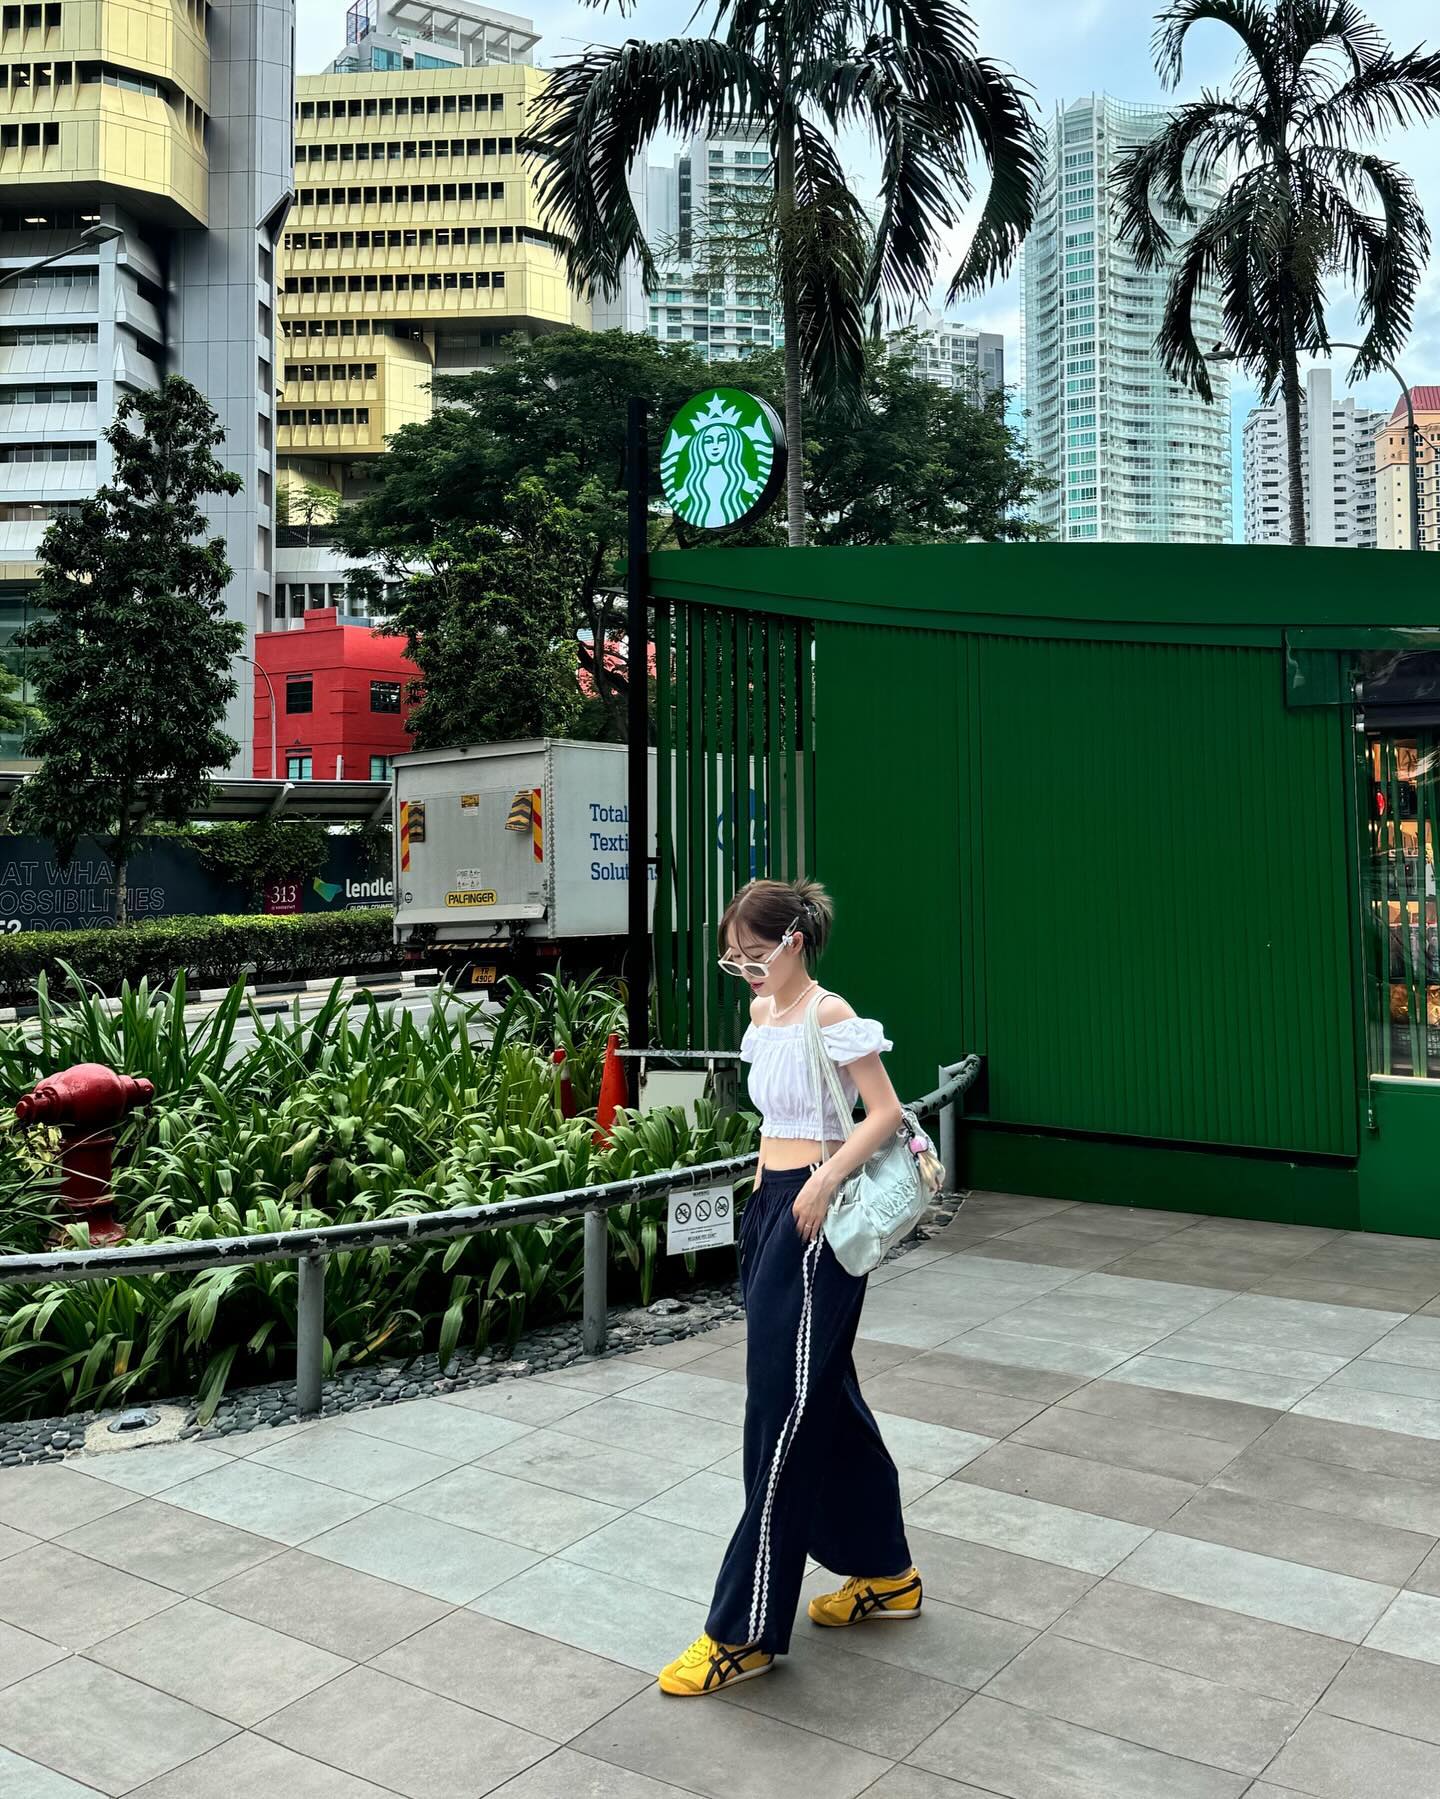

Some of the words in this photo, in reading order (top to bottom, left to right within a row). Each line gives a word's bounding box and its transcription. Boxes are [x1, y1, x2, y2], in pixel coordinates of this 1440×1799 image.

[589, 803, 629, 823] Total
[590, 832, 629, 852] Texti
[0, 861, 39, 886] AT
[45, 860, 128, 885] WHA
[591, 862, 658, 881] Solutn
[271, 885, 297, 904] 313
[346, 877, 393, 898] lendle
[0, 887, 165, 915] OSSIBILIIES
[448, 892, 494, 904] PALFINGER
[79, 915, 134, 930] YO
